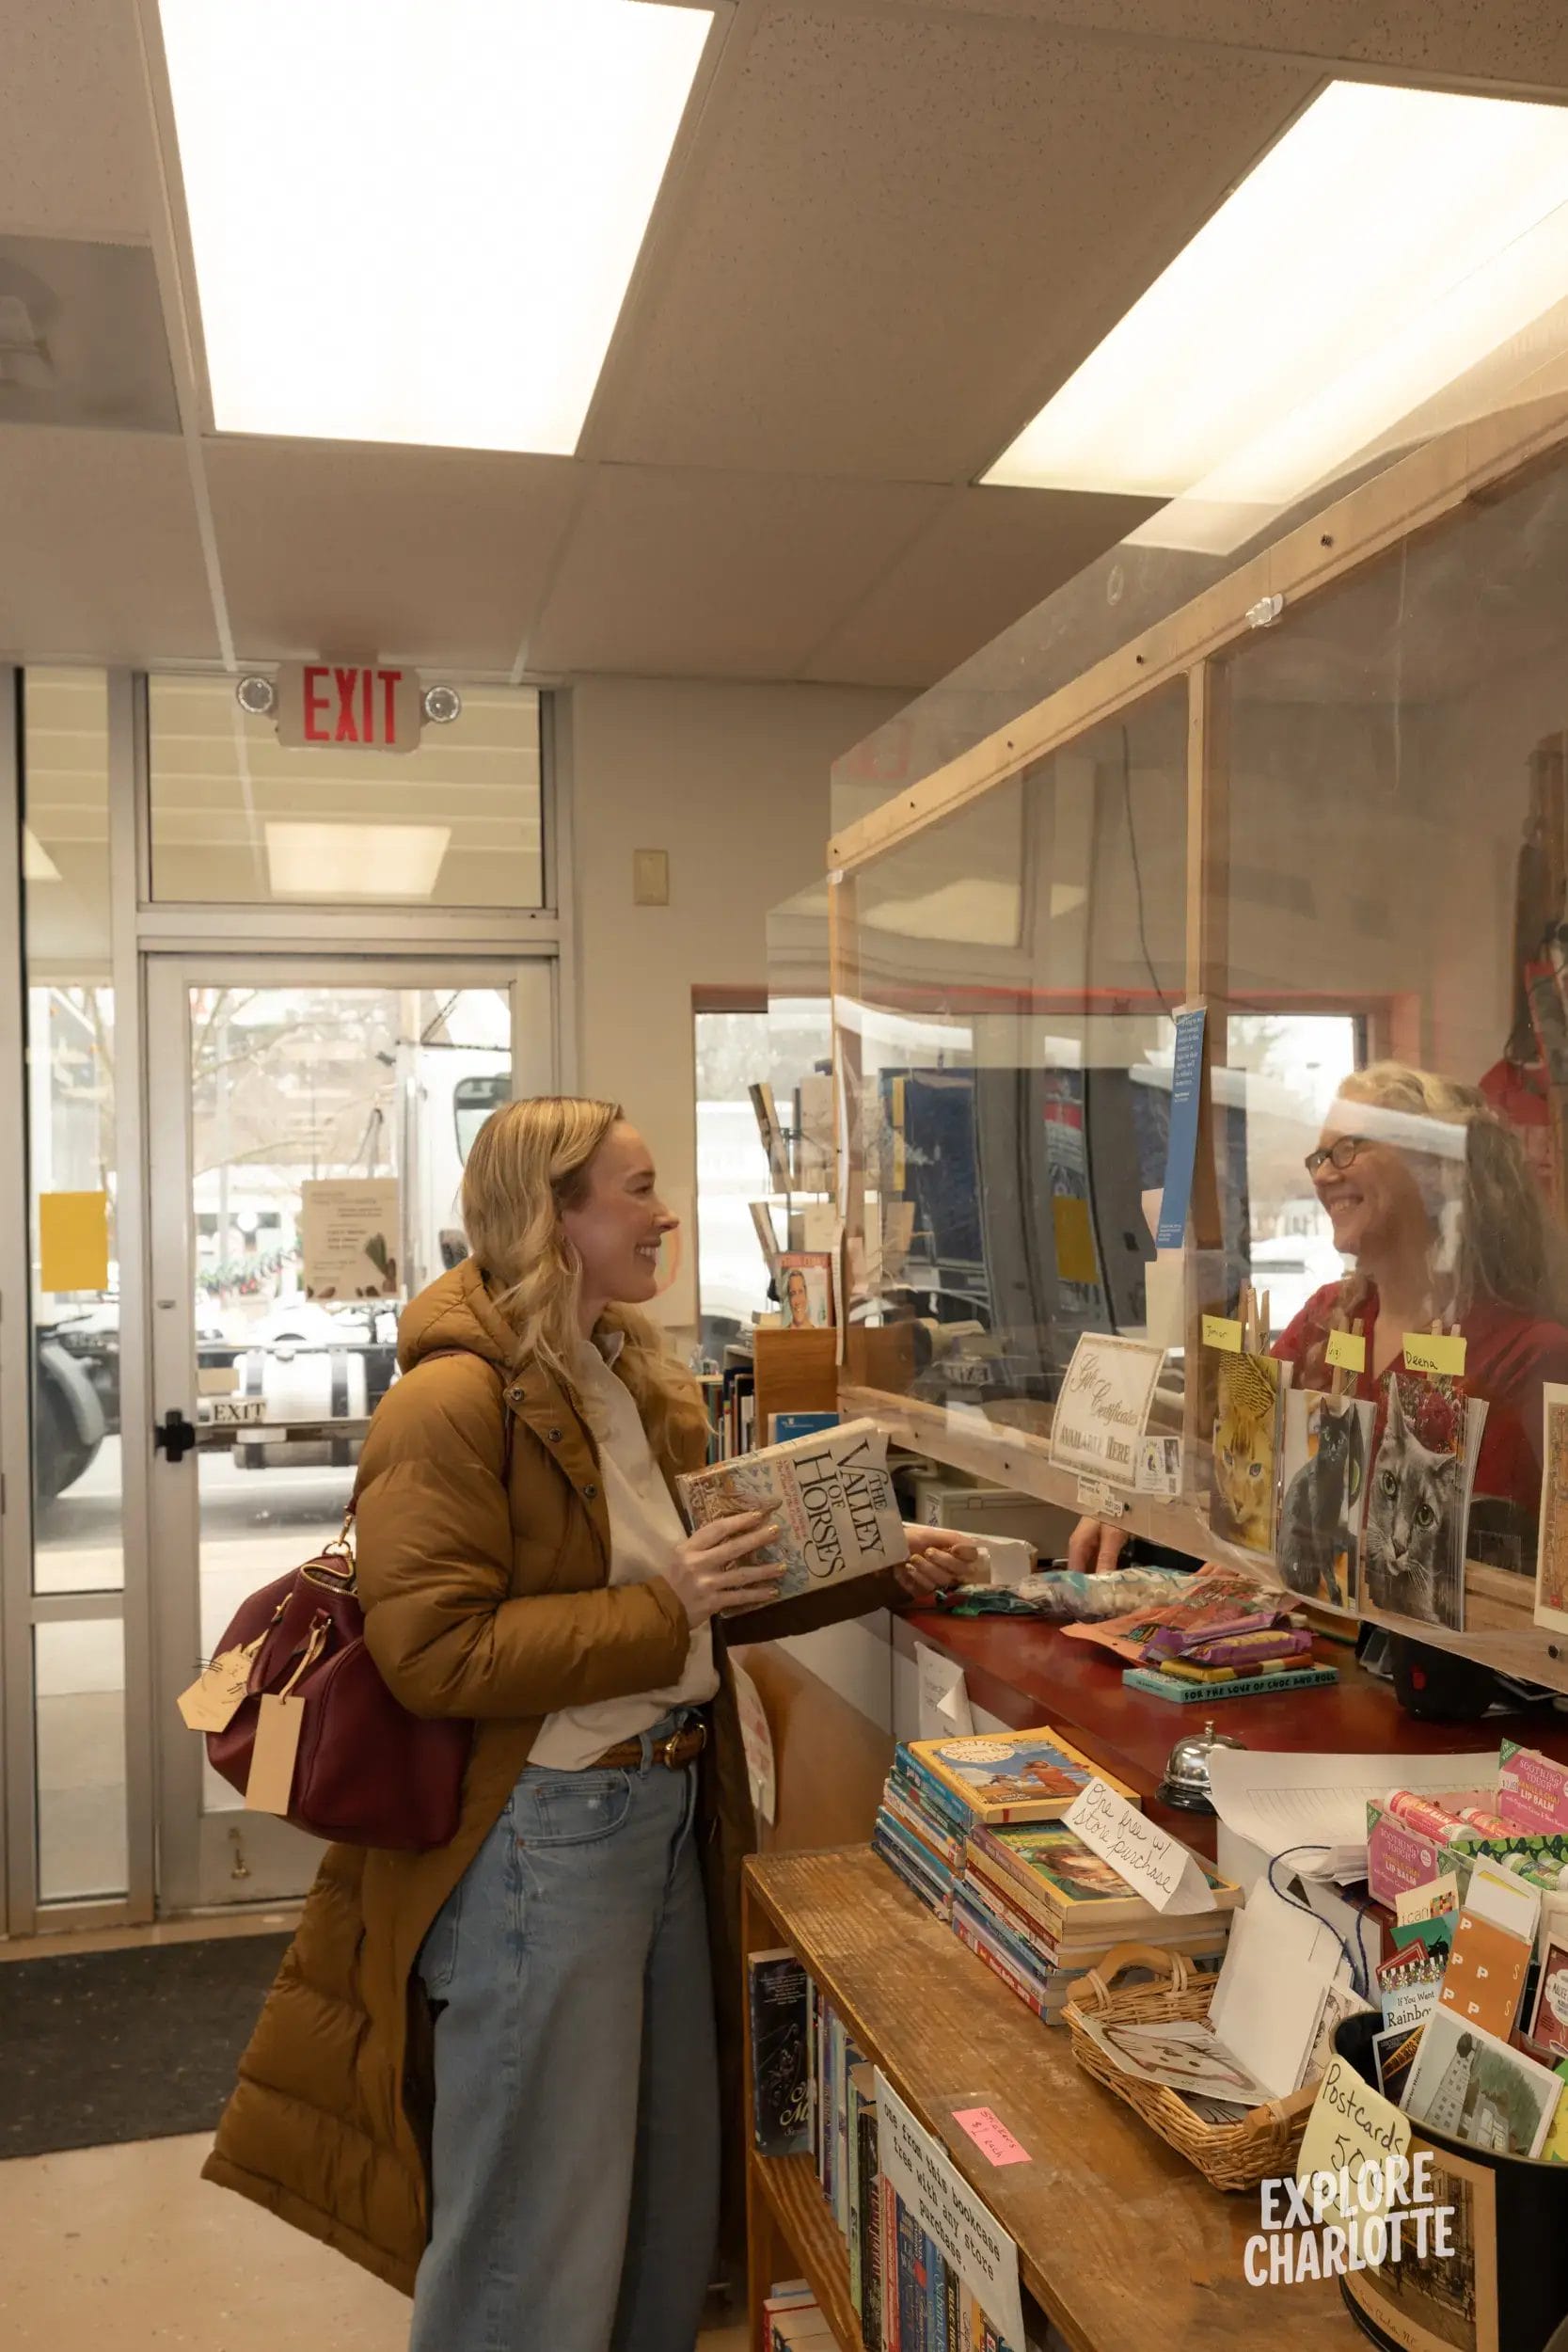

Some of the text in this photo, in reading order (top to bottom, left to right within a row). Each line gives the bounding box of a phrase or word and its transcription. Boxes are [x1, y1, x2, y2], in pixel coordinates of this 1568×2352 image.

[303, 666, 403, 744] EXIT
[1405, 1350, 1438, 1371] Deena
[214, 1402, 266, 1422] EXIT
[1105, 1435, 1131, 1464] HERE
[826, 1483, 846, 1510] OF
[836, 1438, 889, 1557] VALLEY
[867, 1474, 888, 1511] THE
[792, 1449, 847, 1579] HORSES
[1183, 1690, 1204, 1701] FOR
[1207, 1687, 1225, 1698] THE
[1227, 1683, 1251, 1694] LOVE
[1253, 1681, 1265, 1692] OF
[1519, 1759, 1562, 1785] SOOTHING
[1520, 1788, 1555, 1813] LIP BALM
[1085, 1783, 1171, 1861] One free w/
[1072, 1808, 1172, 1895] store purchase
[1386, 1861, 1396, 1874] LIP
[1397, 1867, 1417, 1886] BALM
[1397, 1991, 1435, 2007] If You Want
[1386, 2004, 1433, 2028] Rainbo
[1322, 2062, 1404, 2160] Postcards
[884, 2103, 1002, 2263] one from this bookcase
[893, 2136, 995, 2282] free with any store
[918, 2197, 968, 2273] purchase.
